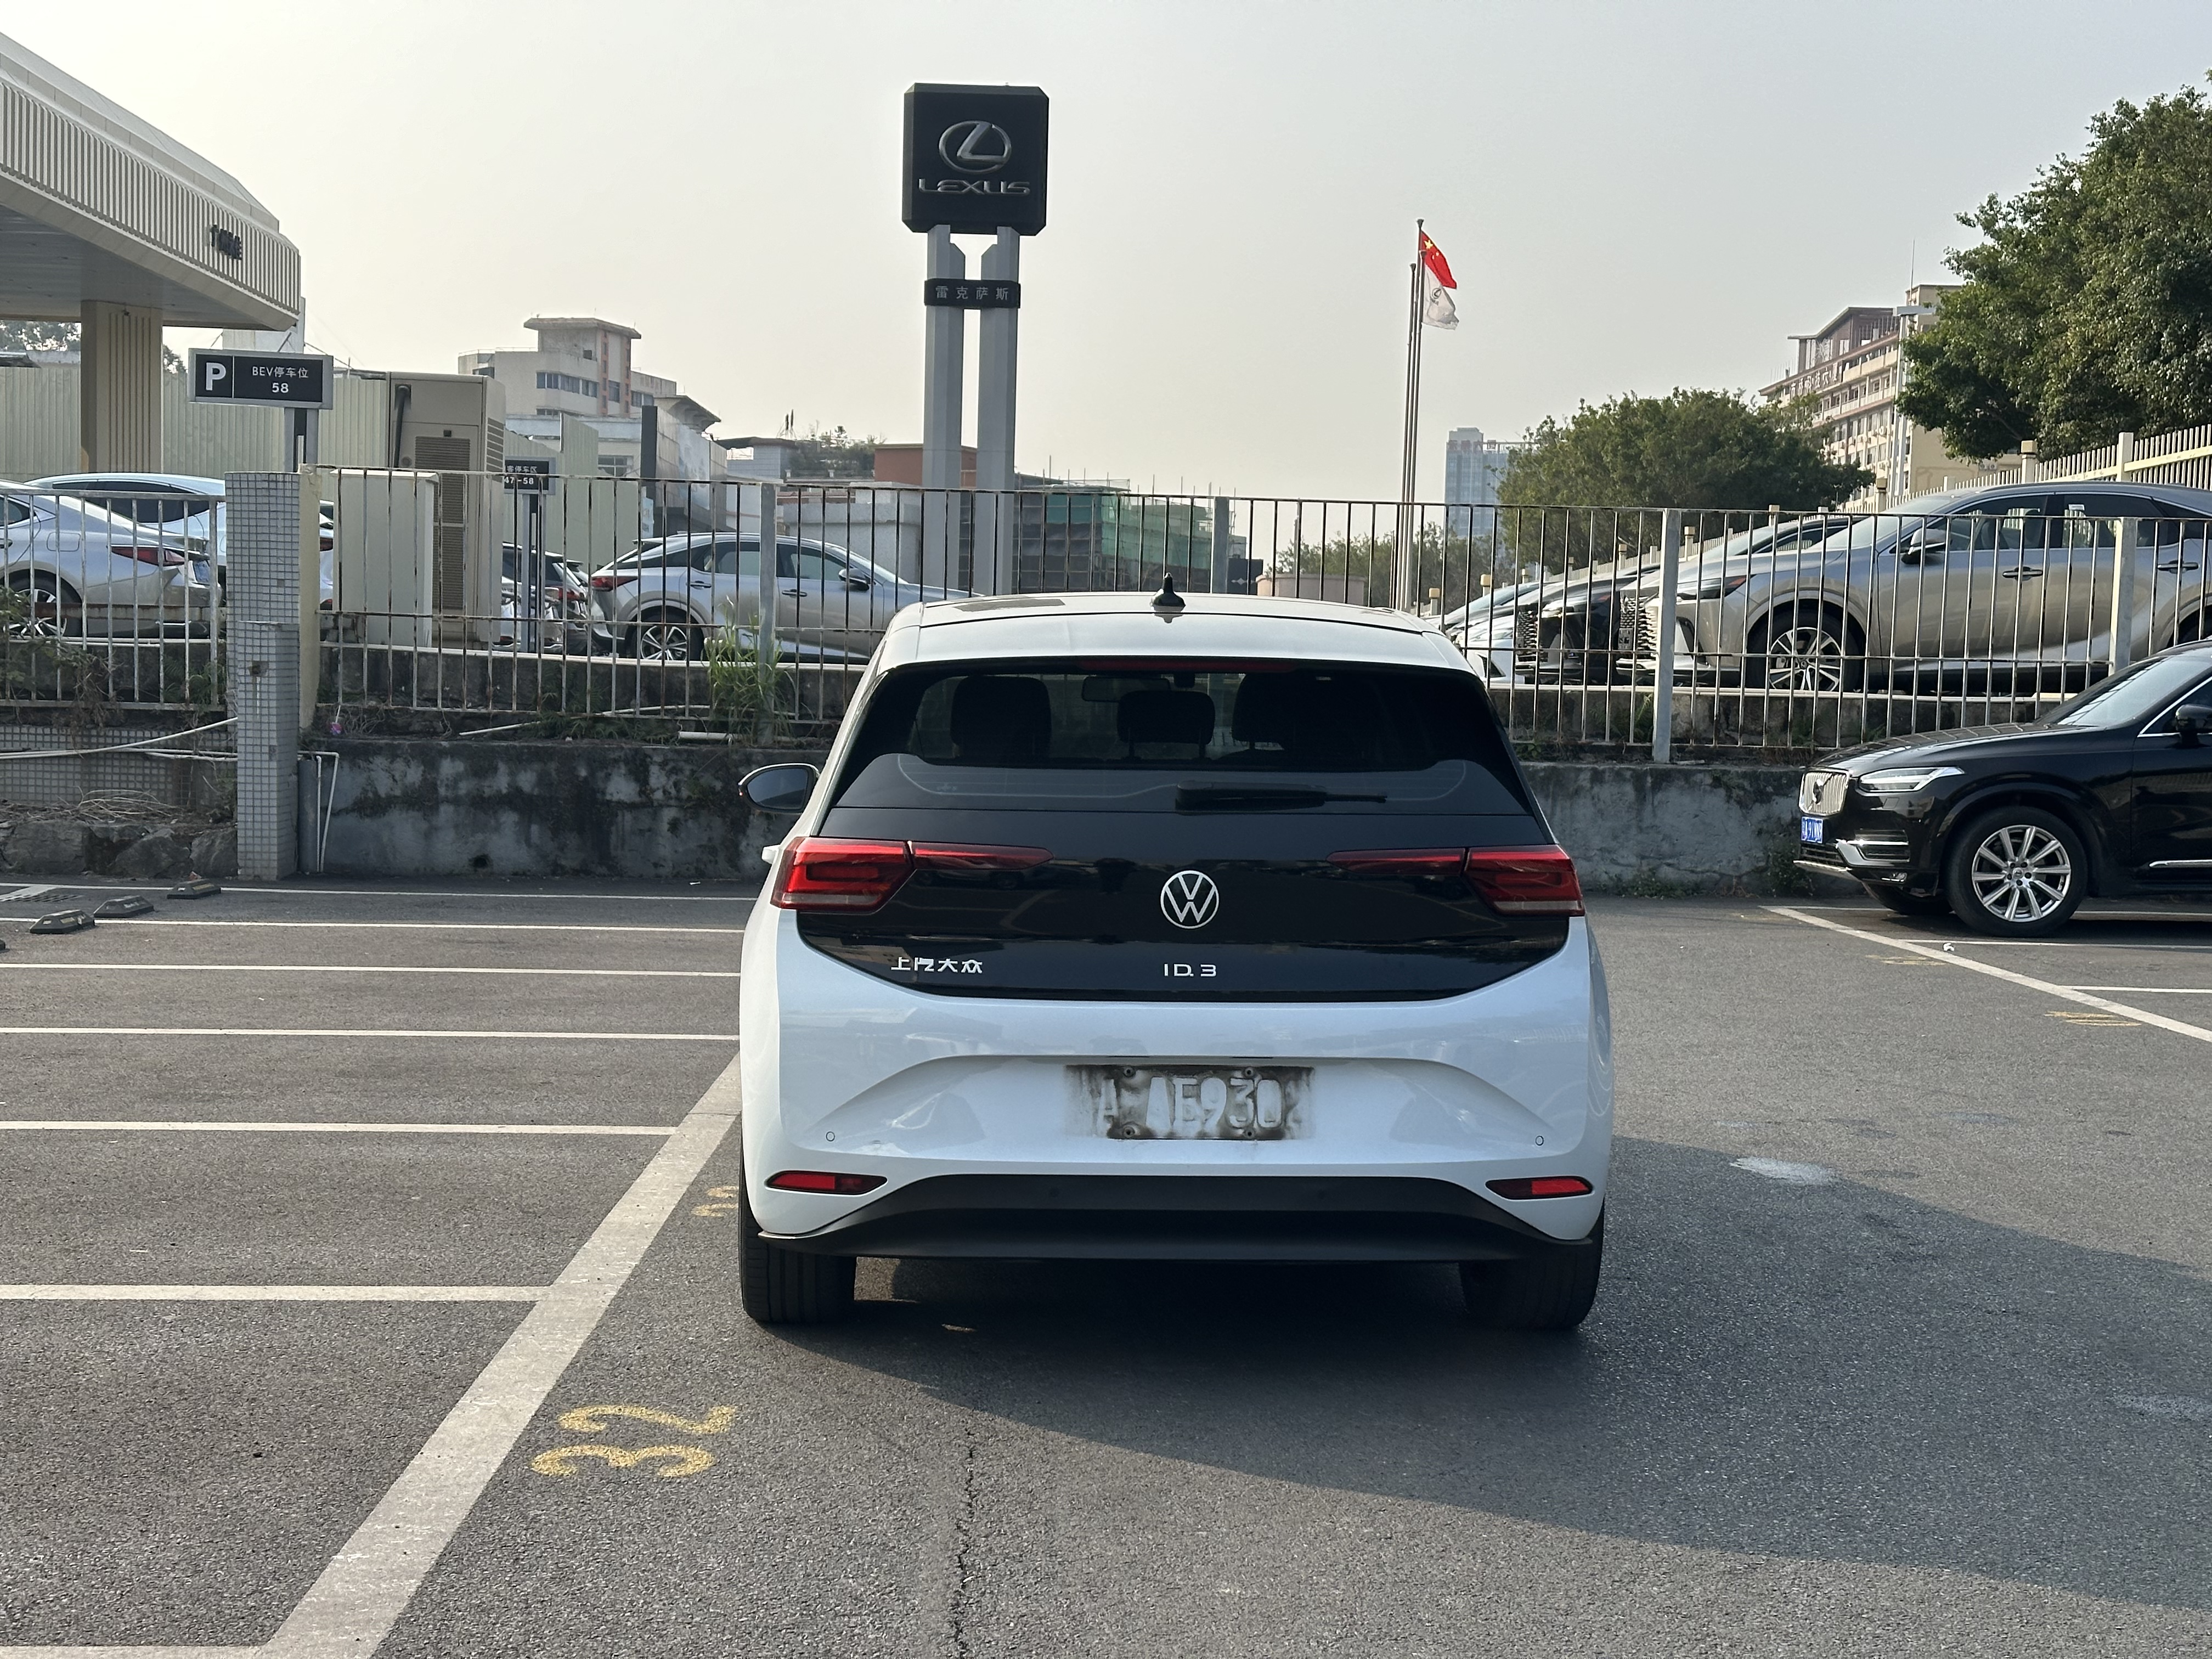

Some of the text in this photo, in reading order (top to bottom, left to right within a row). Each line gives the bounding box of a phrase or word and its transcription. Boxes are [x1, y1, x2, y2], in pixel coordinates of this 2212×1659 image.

[919, 178, 1030, 195] LEXUS
[935, 285, 1009, 300] 雷克萨斯
[205, 362, 226, 391] P
[252, 366, 309, 379] BEV停车位
[272, 383, 289, 393] 58
[891, 957, 983, 974] 上汽大众
[1164, 963, 1216, 977] ID.3
[531, 1404, 736, 1477] 32
